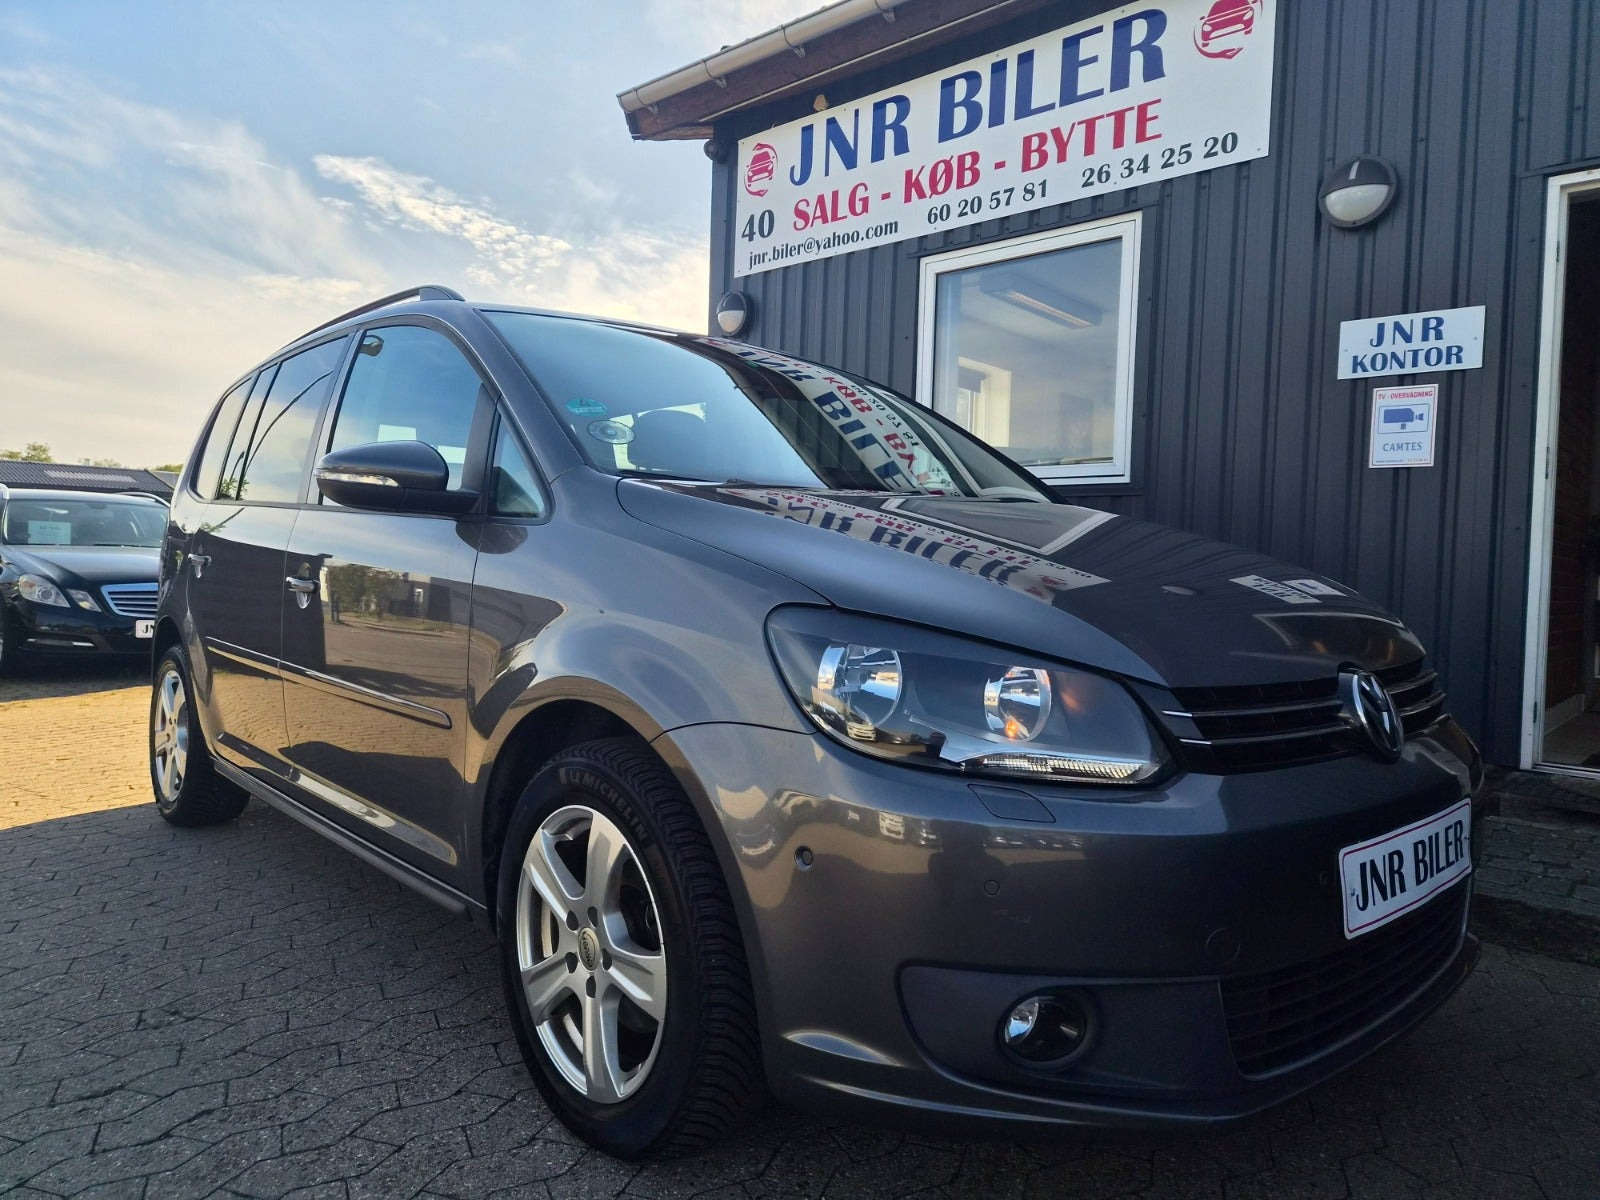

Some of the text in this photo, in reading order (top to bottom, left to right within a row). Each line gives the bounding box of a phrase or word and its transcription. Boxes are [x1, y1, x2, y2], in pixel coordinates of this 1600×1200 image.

[789, 9, 1167, 186] JNR BILER
[793, 182, 870, 231] SALG
[903, 150, 981, 204] KØB
[1021, 98, 1163, 173] BYTTE
[927, 132, 1238, 225] 60 20 57 81 26 34 25 20
[741, 209, 775, 242] 40
[749, 221, 899, 270] jnr.biler@yahoo.com
[1352, 345, 1464, 374] KONTOR
[1370, 316, 1445, 348] JNR
[1382, 442, 1423, 452] CAMTES
[583, 772, 649, 841] MICHELIN
[1356, 820, 1464, 911] JNR BILER
